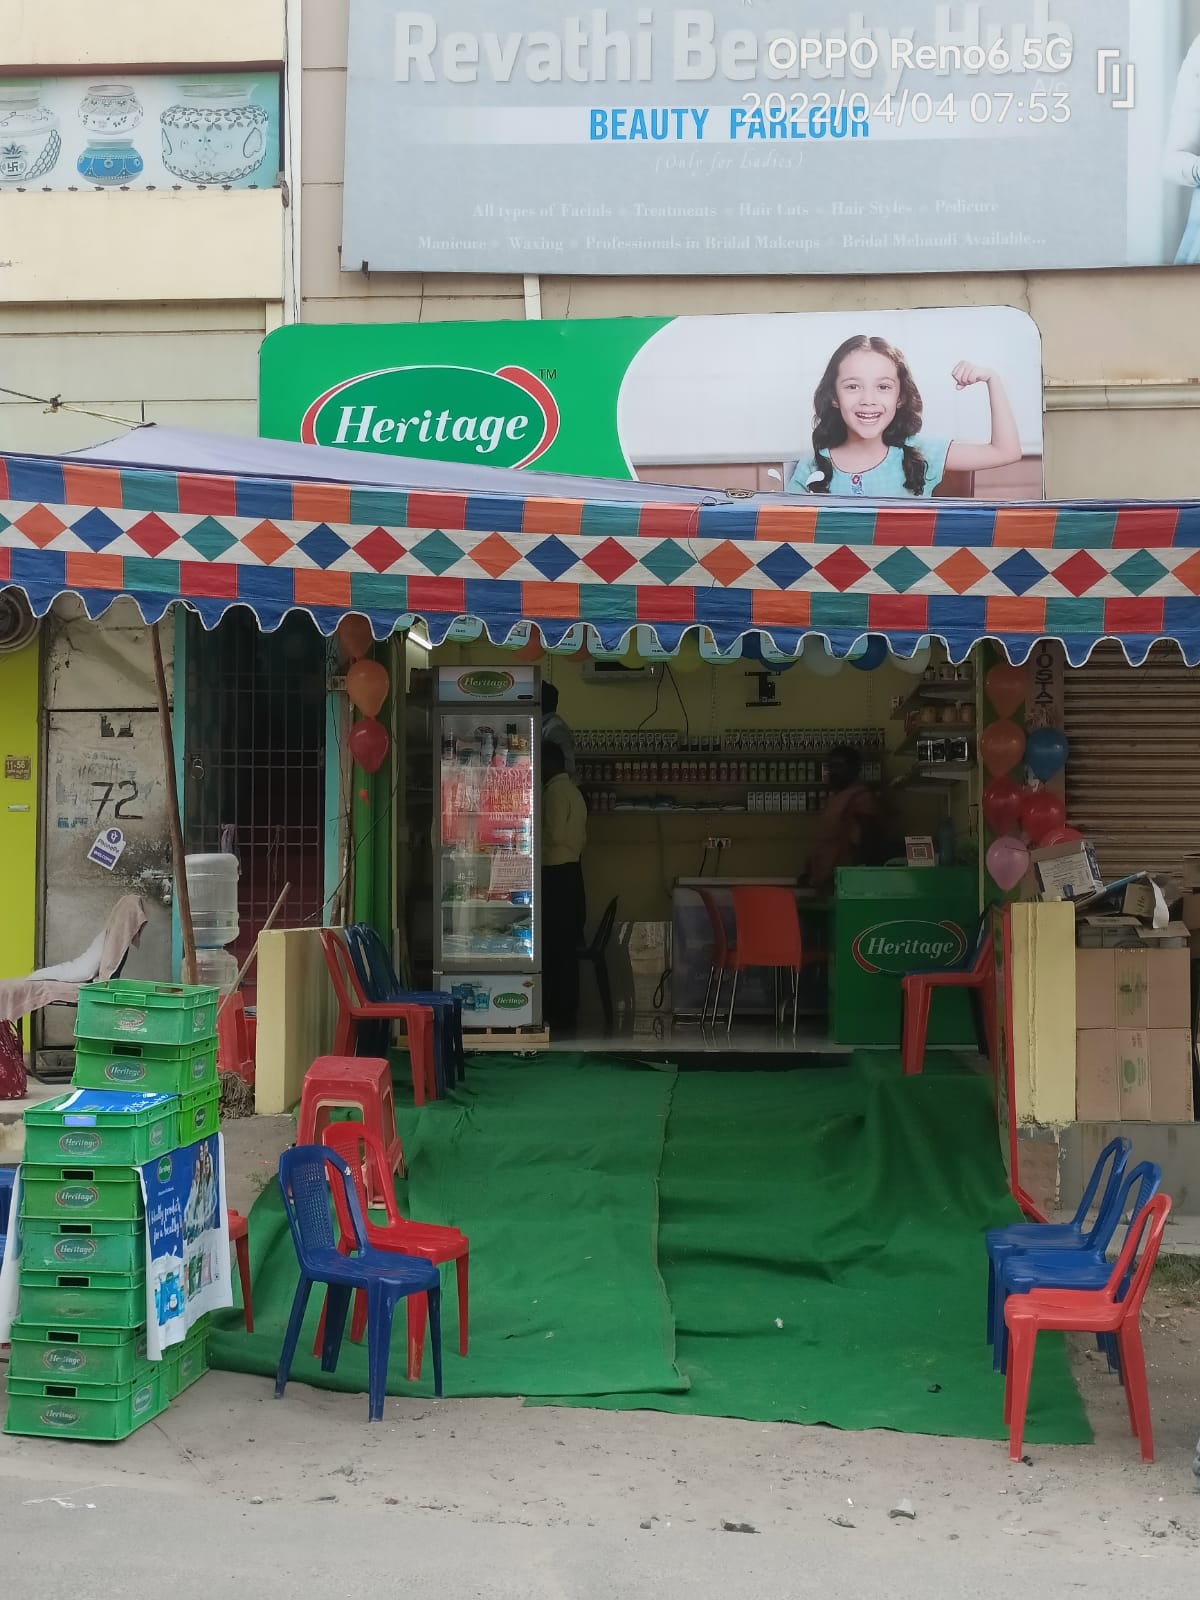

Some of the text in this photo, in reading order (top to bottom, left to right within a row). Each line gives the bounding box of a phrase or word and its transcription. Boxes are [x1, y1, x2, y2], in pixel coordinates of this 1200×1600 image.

[393, 0, 1074, 96] Revathi Beauty Hub
[590, 107, 870, 140] BEAUTY PARLOUR
[472, 199, 1000, 222] All types of Facials Treatments Hair Cuts Hair Styles Pedicure
[417, 235, 488, 250] Manicure
[508, 235, 564, 255] Waxing
[584, 235, 683, 250] Professionals
[685, 235, 700, 250] in
[705, 234, 750, 250] Bridal
[754, 235, 821, 253] Makeups
[842, 233, 888, 249] Bridal
[331, 368, 557, 453] Heritage TM
[463, 677, 509, 689] Heritage
[90, 780, 144, 824] 72
[866, 937, 954, 959] Heritage
[496, 996, 525, 1006] Heritage
[109, 1065, 141, 1077] Heritage
[64, 1138, 97, 1149] Heritage
[61, 1192, 94, 1202] Heritage
